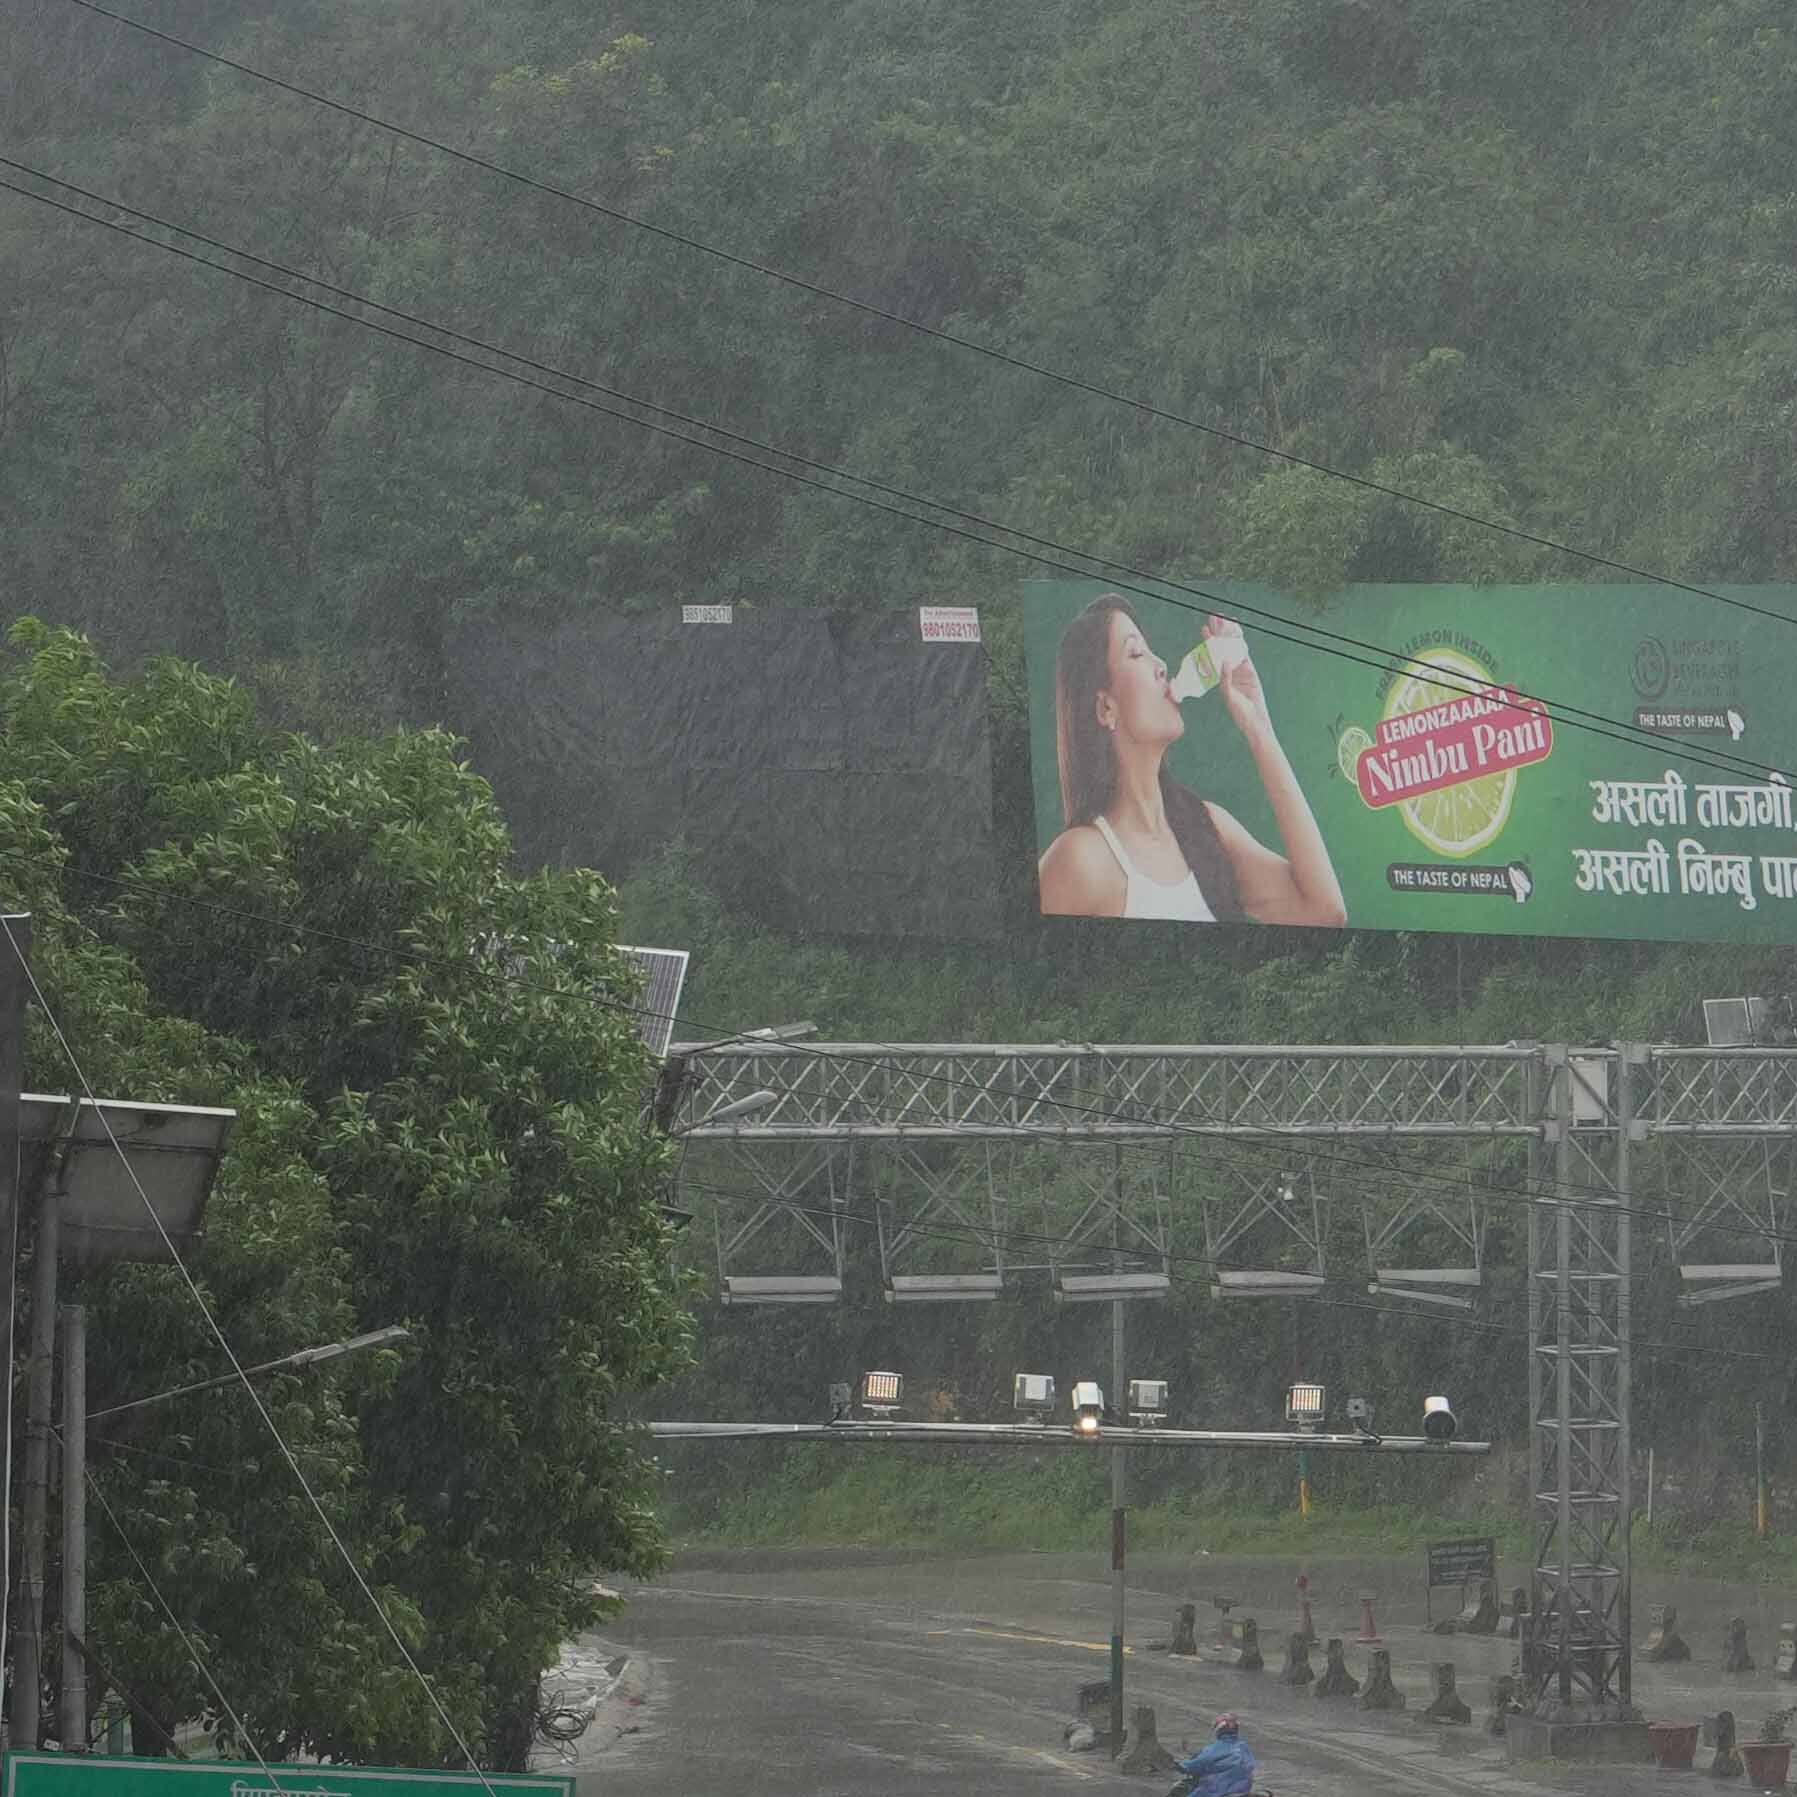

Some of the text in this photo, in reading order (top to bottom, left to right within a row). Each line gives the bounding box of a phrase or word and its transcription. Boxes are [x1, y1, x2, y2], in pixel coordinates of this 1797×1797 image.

[1639, 714, 1725, 729] THE TASTE OF NEPAL
[1366, 707, 1546, 797] Nimbu Pani
[1589, 769, 1687, 827] असली
[1393, 869, 1508, 889] THE TASTE OF NEPAL
[1572, 838, 1669, 895] असली
[1677, 838, 1758, 910] निम्बु
